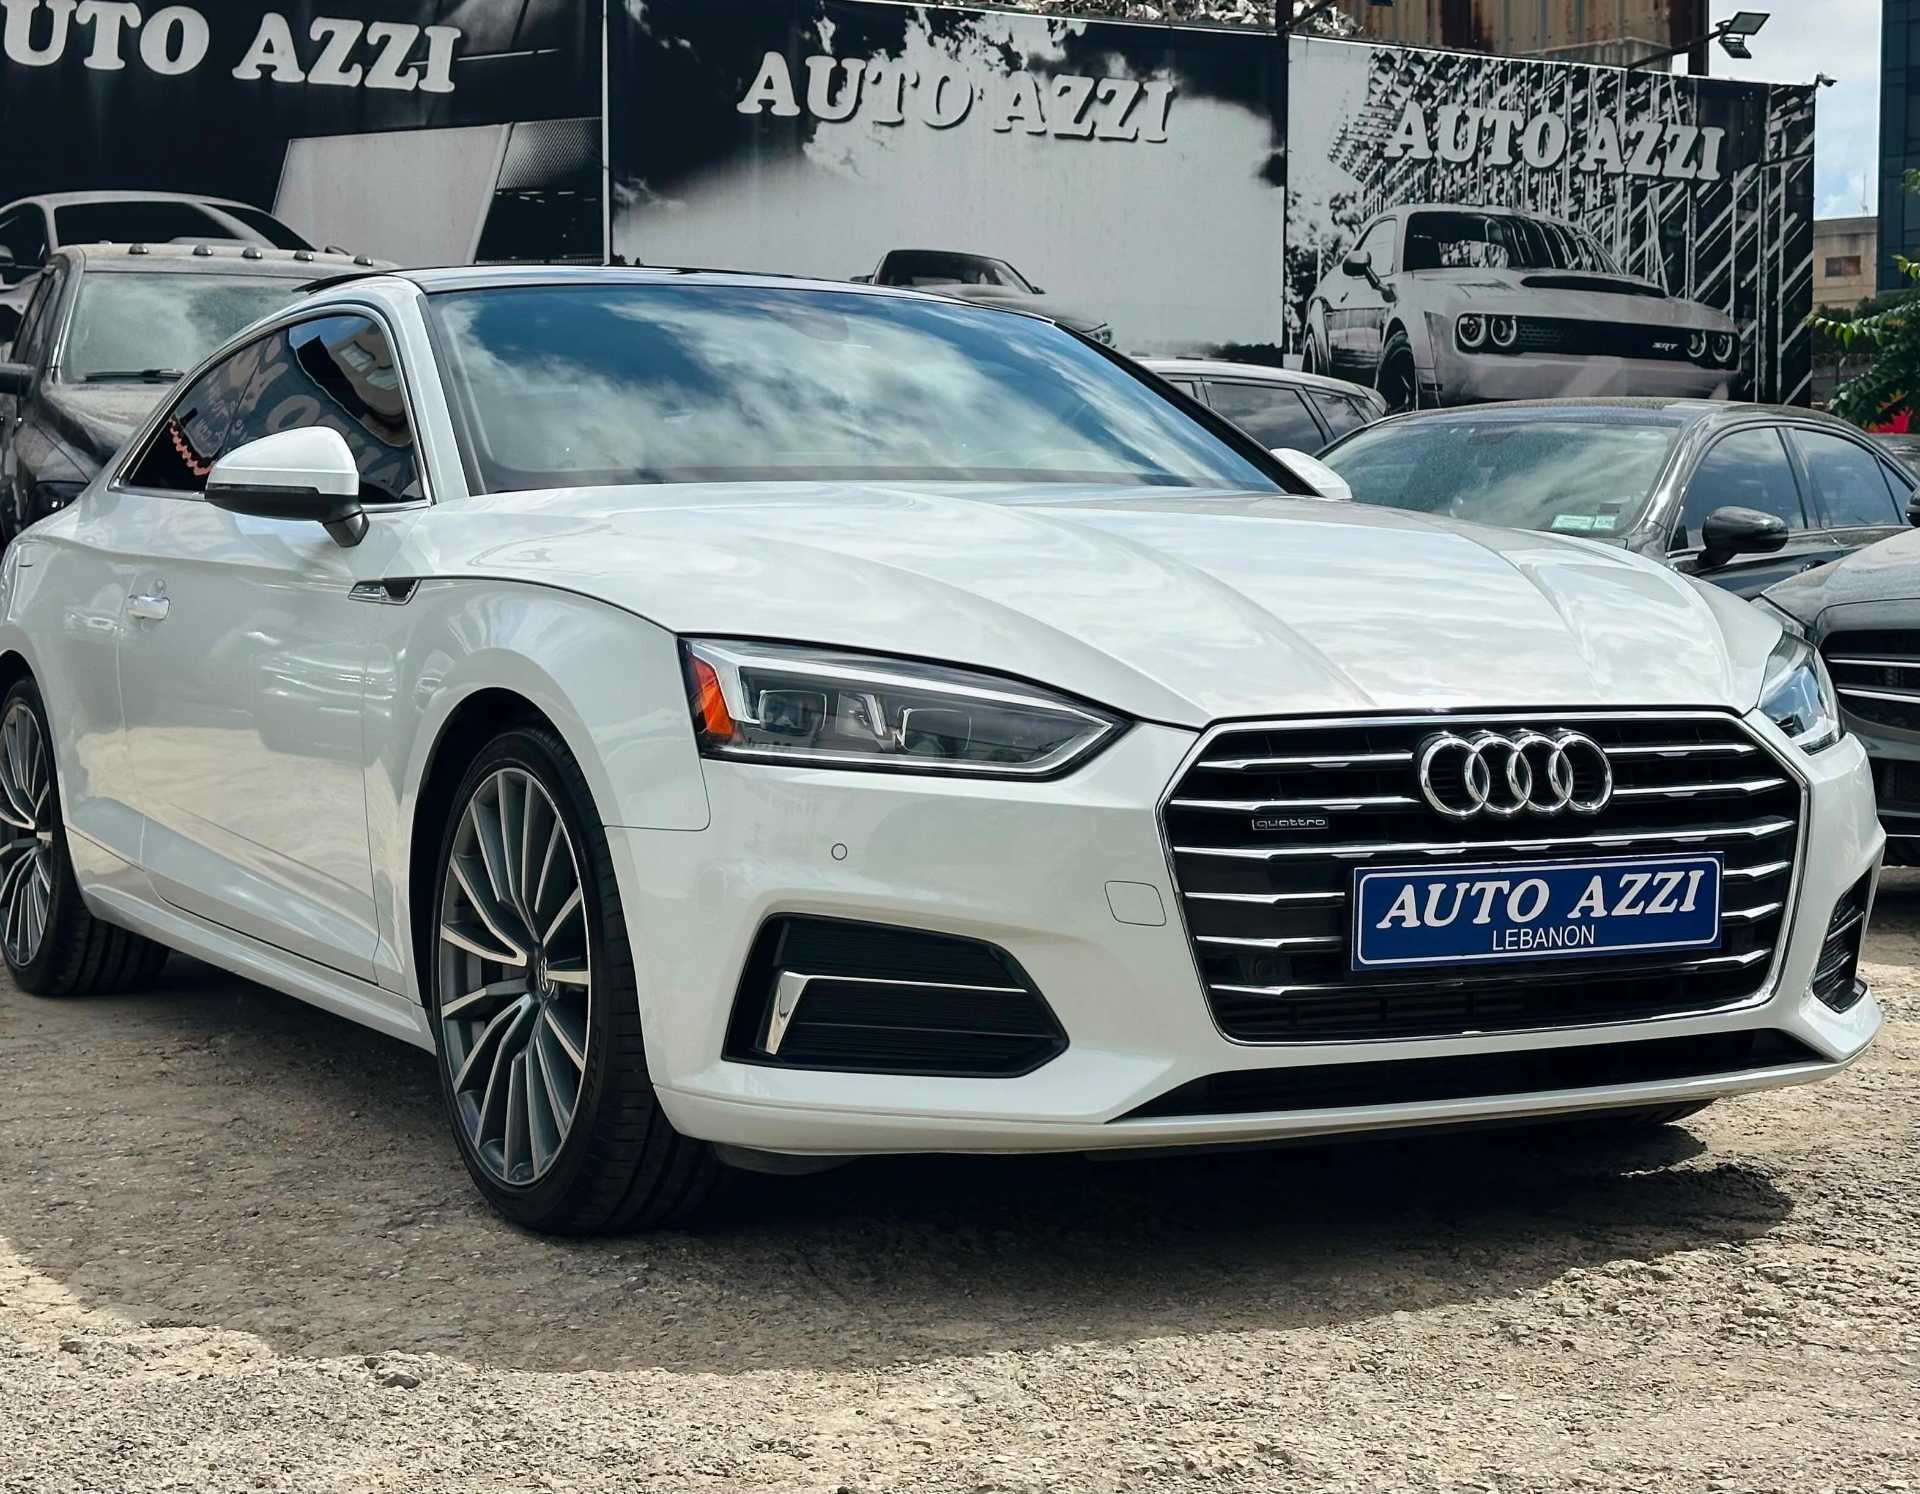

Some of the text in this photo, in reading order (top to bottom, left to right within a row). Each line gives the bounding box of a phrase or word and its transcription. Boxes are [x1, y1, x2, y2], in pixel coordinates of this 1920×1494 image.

[231, 12, 461, 93] AZZI
[737, 51, 1173, 143] AUTO AZZI
[1384, 100, 1726, 181] AUTO AZZI
[1256, 818, 1326, 829] quattro
[1376, 869, 1706, 929] AUTO AZZI
[1492, 924, 1596, 951] LEBANON
